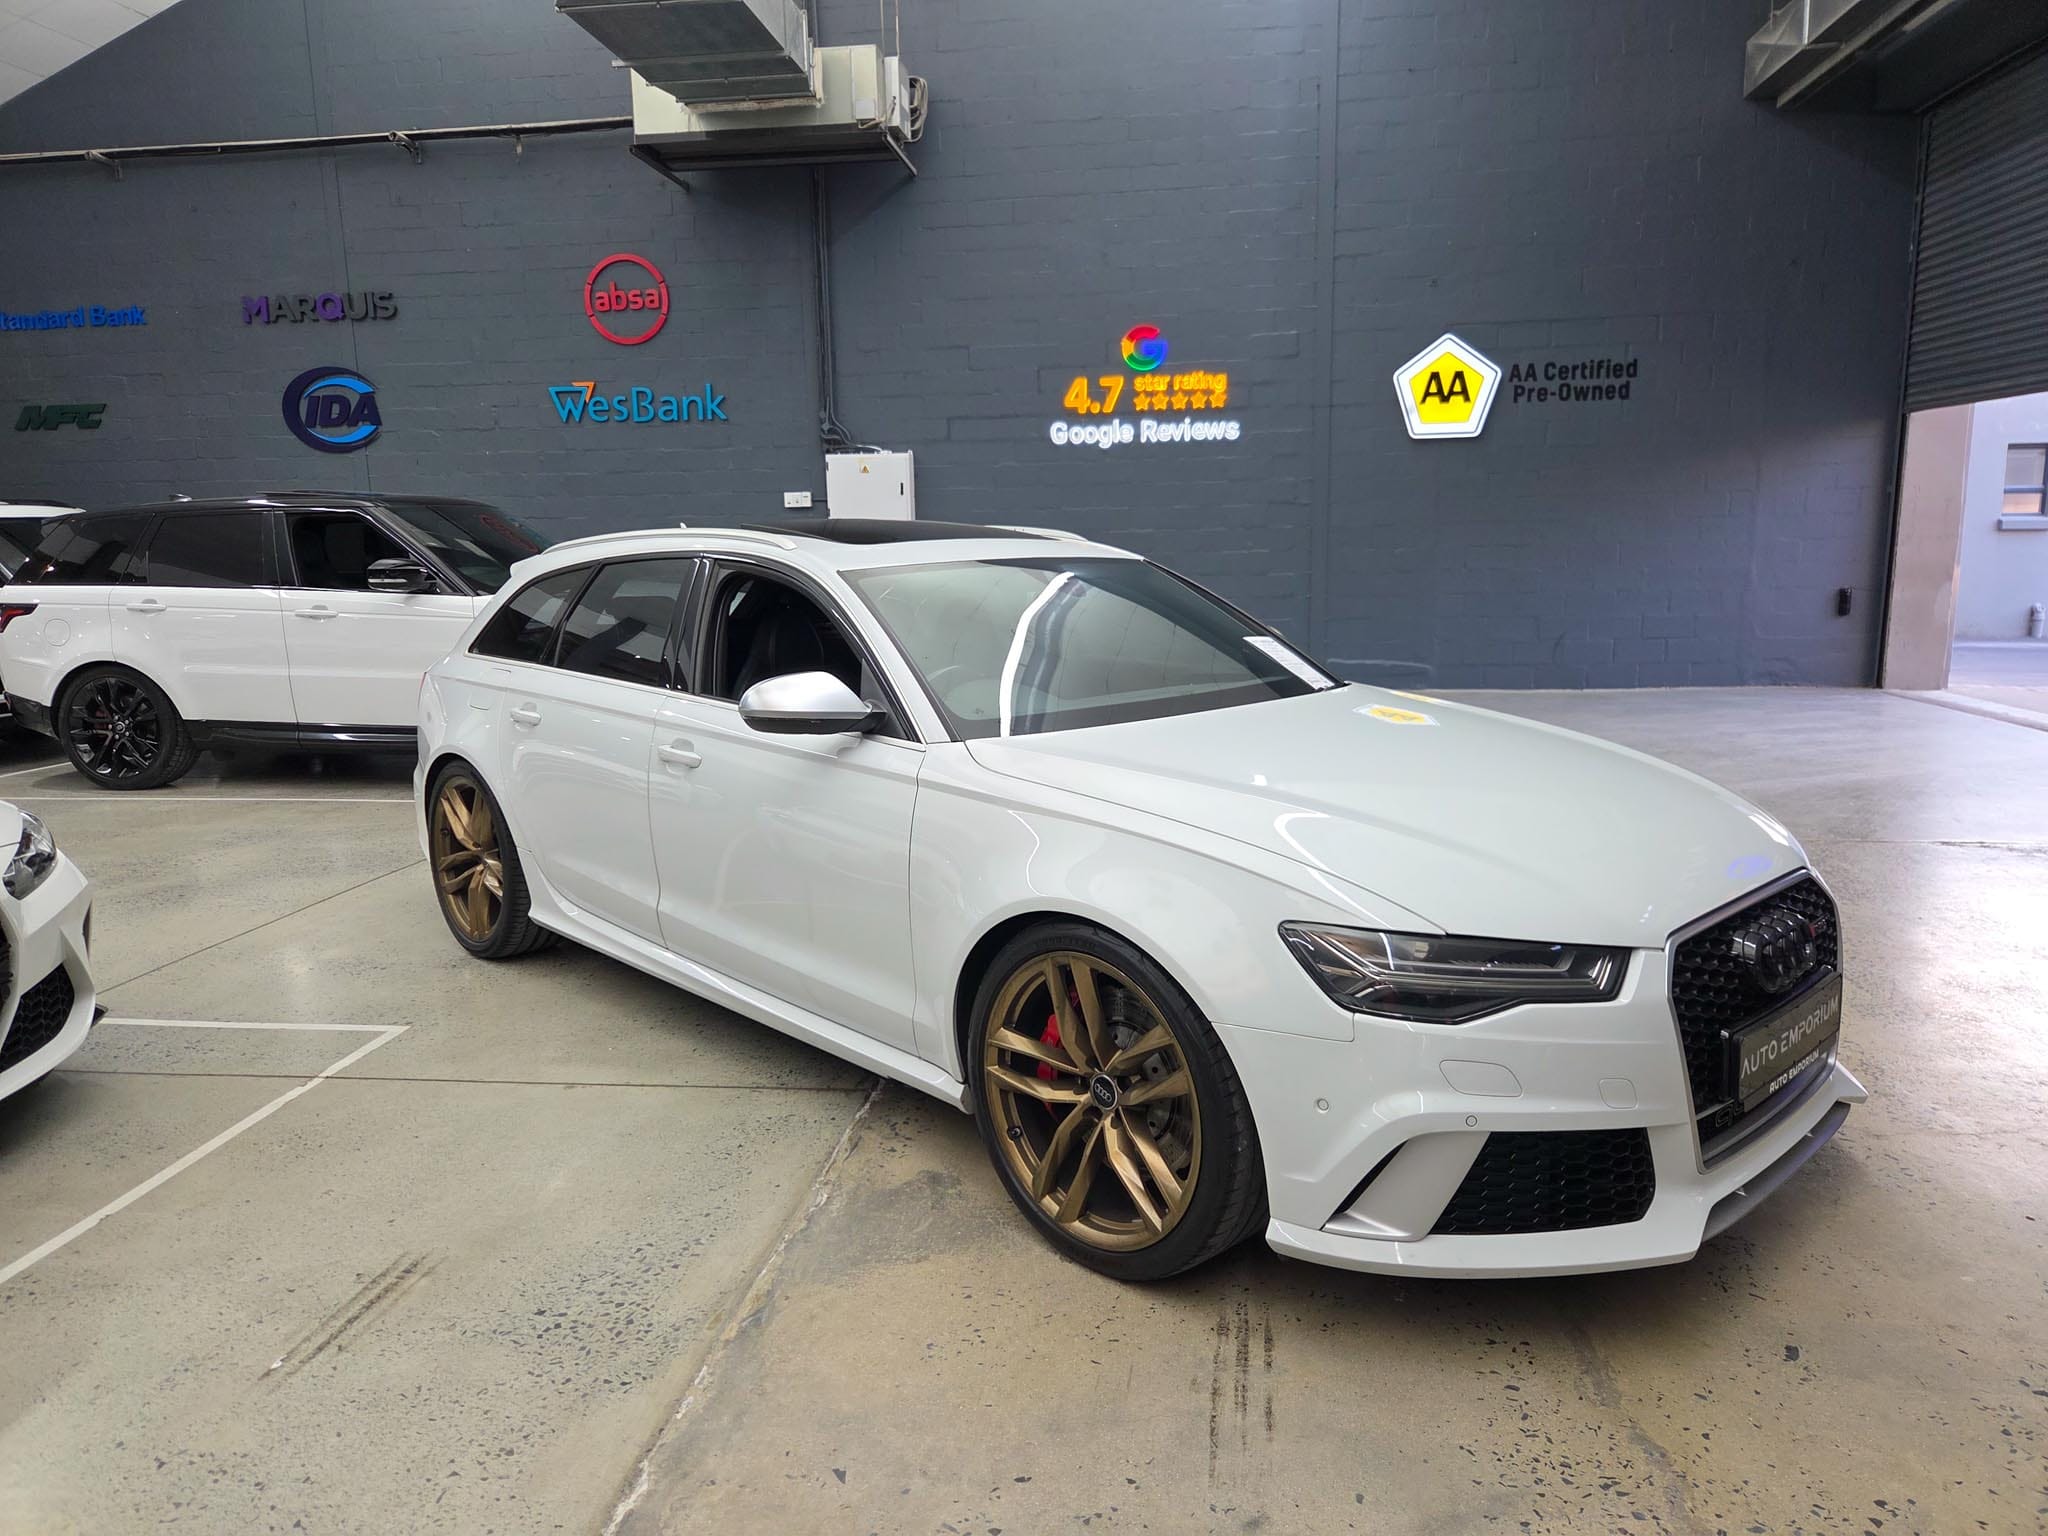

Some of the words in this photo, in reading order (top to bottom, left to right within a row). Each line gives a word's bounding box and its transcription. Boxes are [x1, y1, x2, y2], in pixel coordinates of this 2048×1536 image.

[241, 291, 396, 324] MARQUIS
[594, 281, 660, 311] absa
[0, 305, 85, 331] tandard
[89, 304, 147, 326] Bank
[1133, 374, 1170, 391] star
[1173, 371, 1228, 392] rating
[1508, 363, 1538, 382] AA
[1543, 358, 1638, 381] Certified
[548, 381, 728, 423] WesBank
[1064, 376, 1125, 414] 4.7
[1420, 370, 1471, 405] AA
[1513, 380, 1630, 403] Pre-Owned
[304, 393, 382, 428] IDA
[1050, 418, 1135, 449] Google
[1140, 416, 1240, 443] Reviews
[1741, 1039, 1778, 1079] AUTO
[1780, 995, 1839, 1053] EMPORIUM
[1769, 1073, 1788, 1094] AUTO
[1788, 1049, 1820, 1081] EMPORIUM
